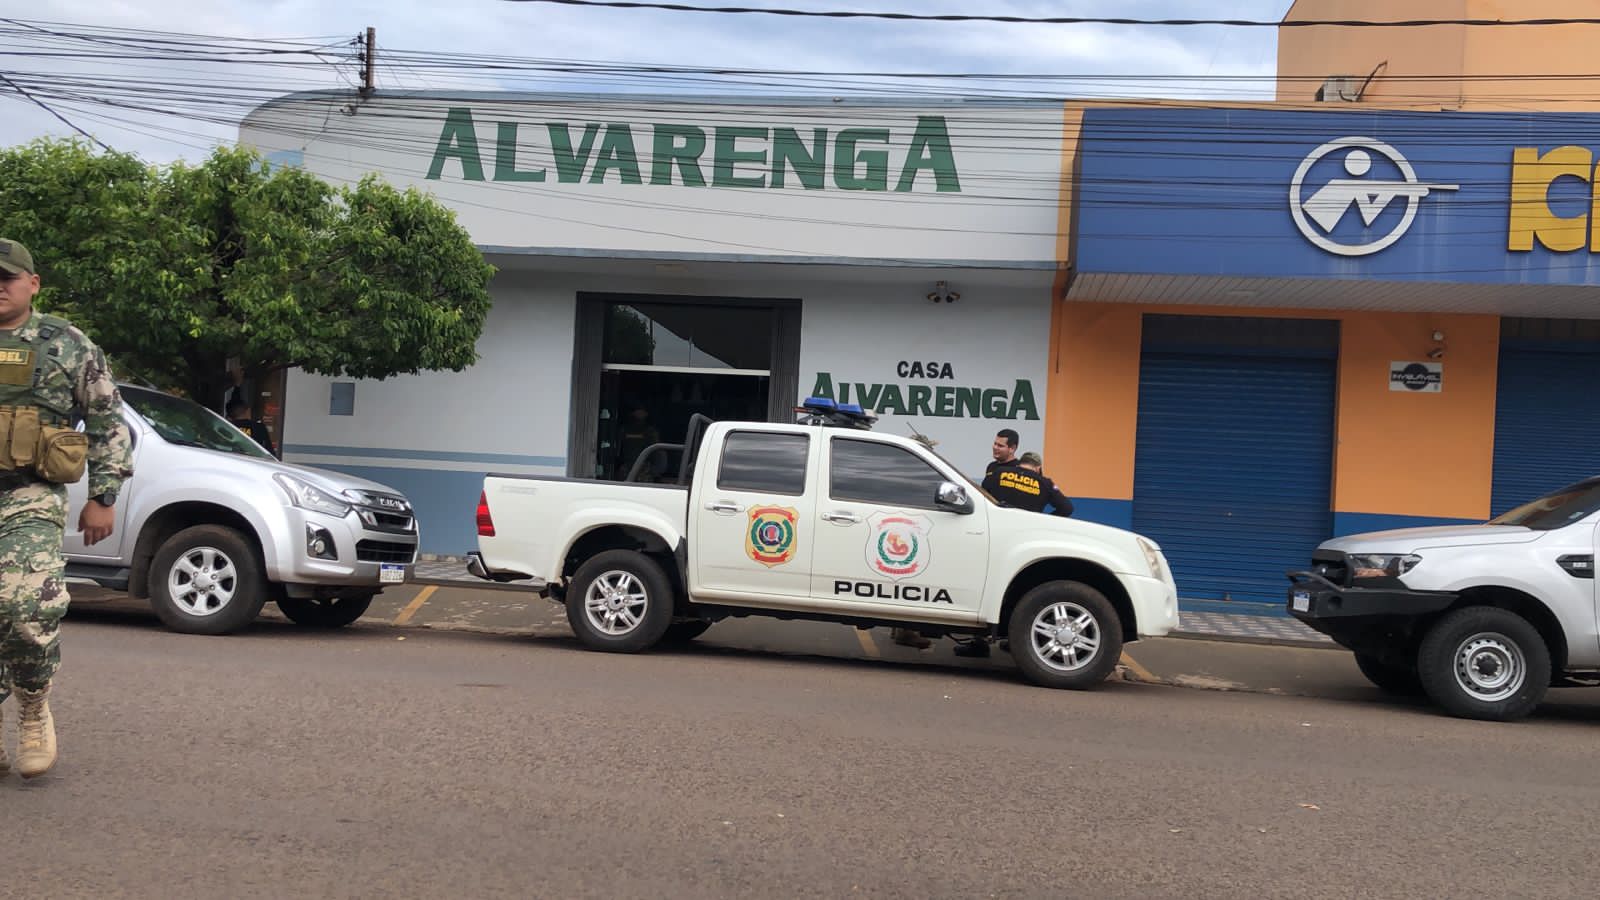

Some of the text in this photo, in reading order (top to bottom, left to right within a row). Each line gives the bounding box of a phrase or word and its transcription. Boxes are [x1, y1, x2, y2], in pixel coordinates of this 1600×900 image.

[425, 107, 962, 193] ALVARENGA
[896, 360, 955, 380] CASA
[1000, 472, 1040, 489] POLICIA
[833, 580, 954, 604] POLICIA
